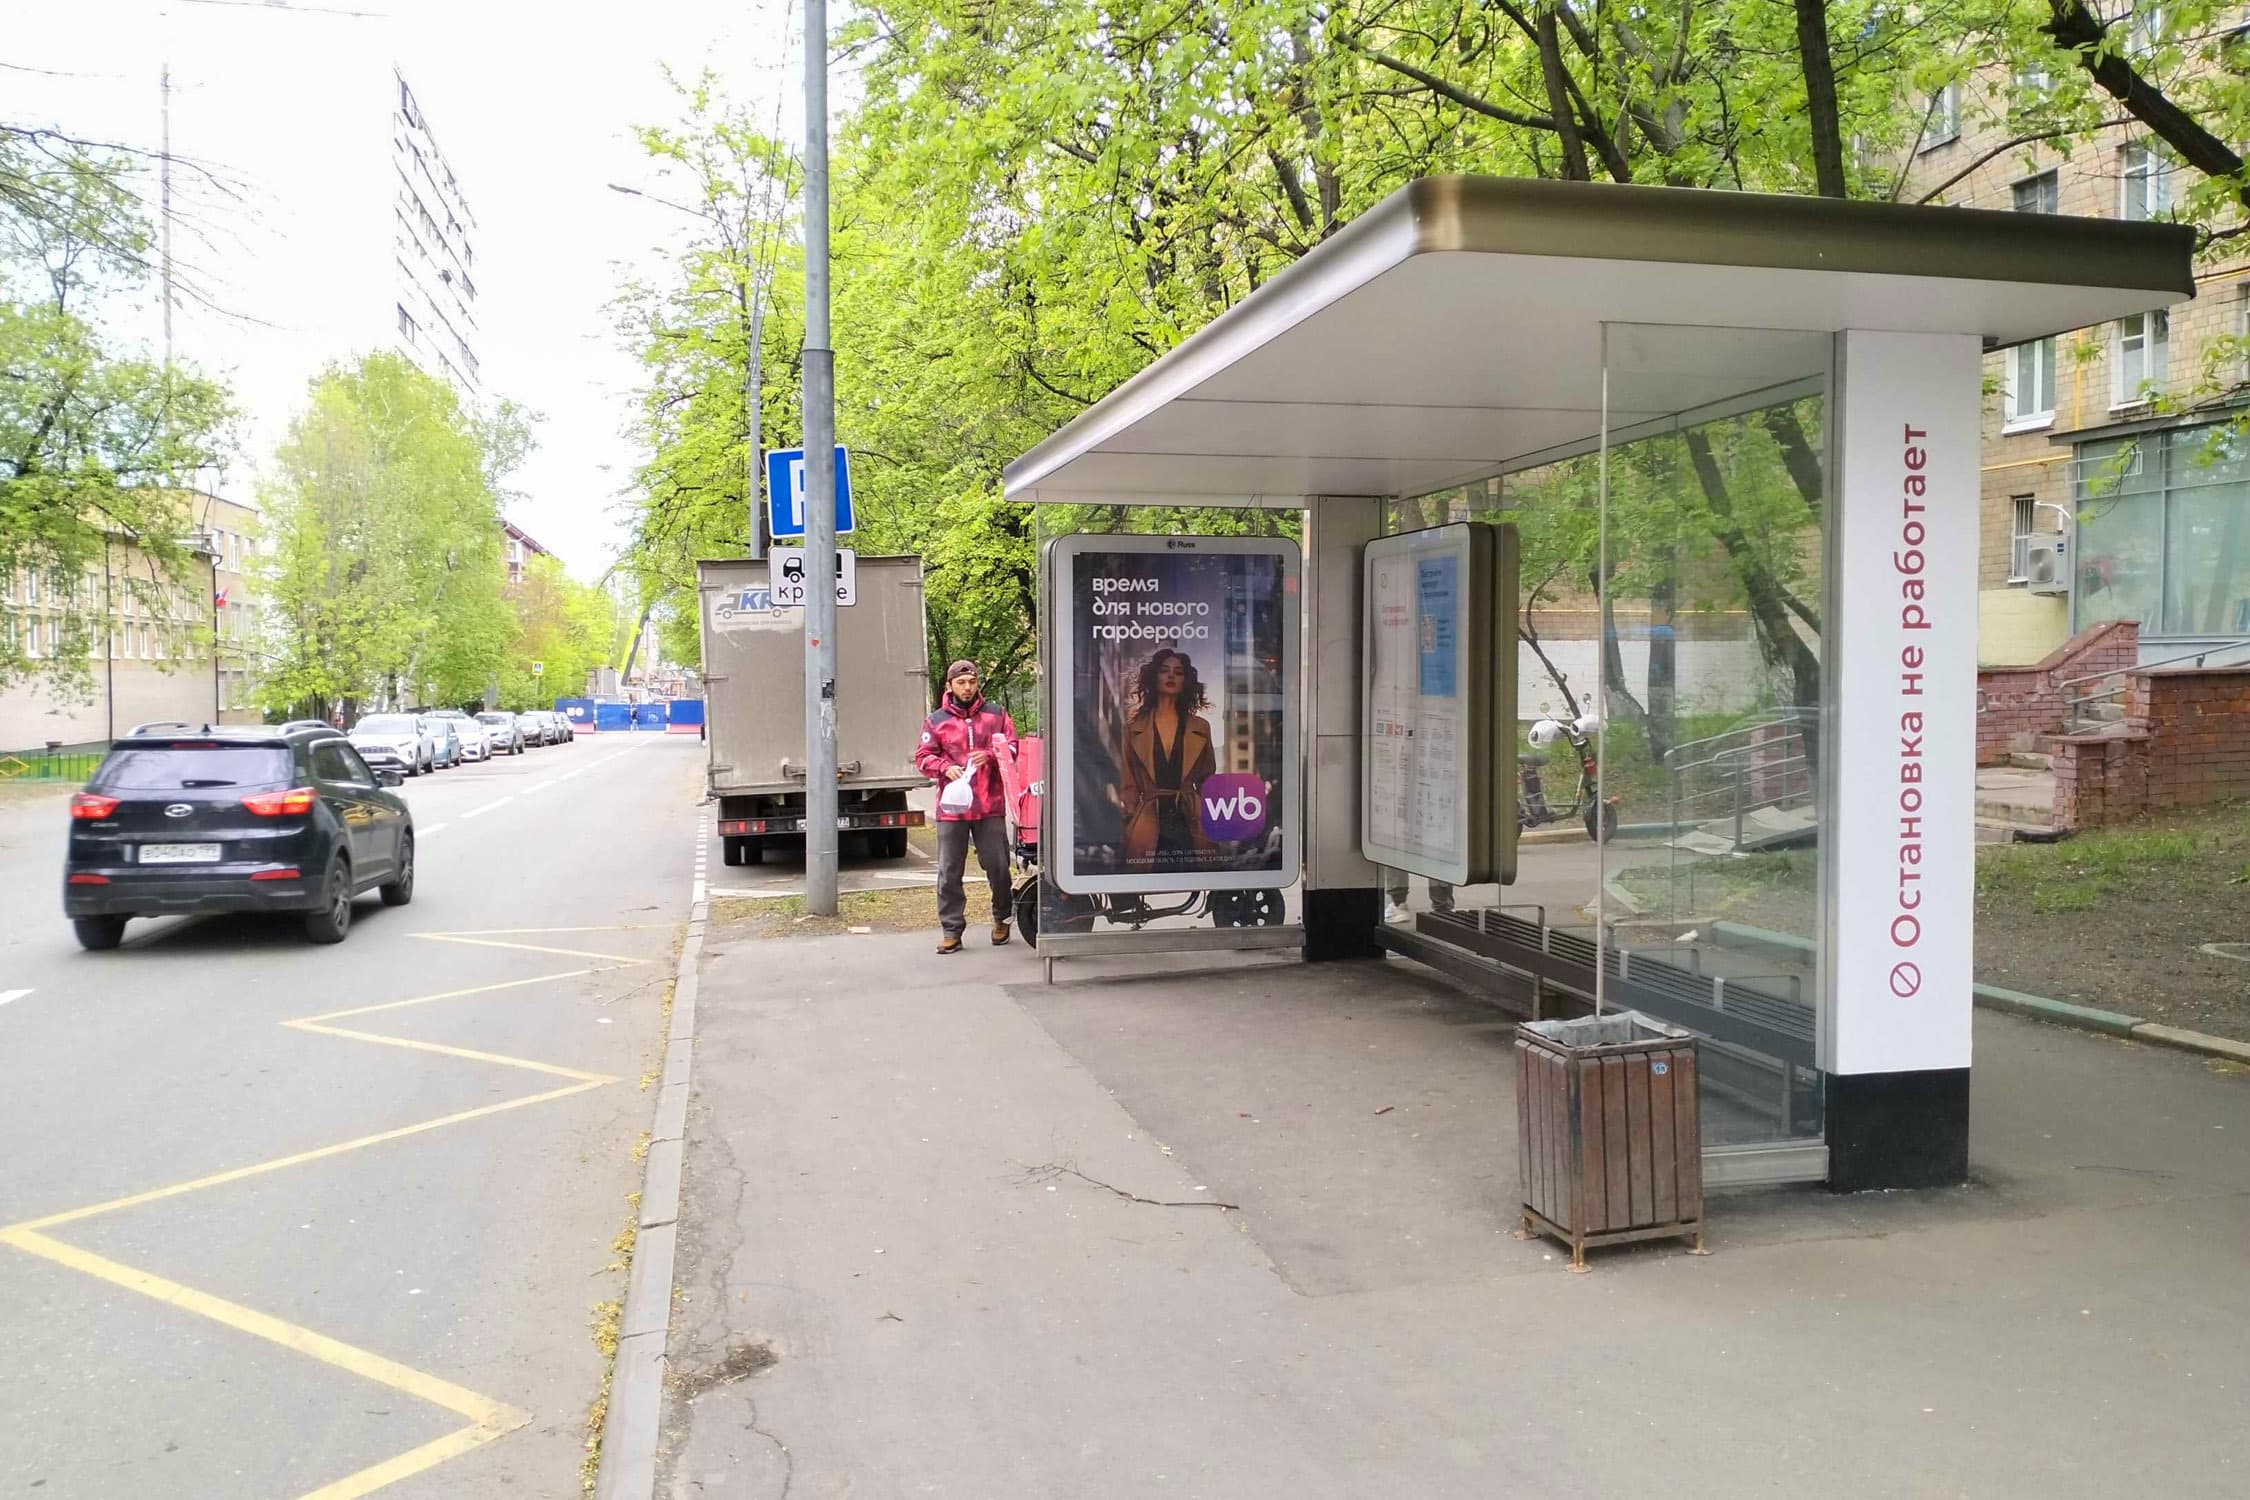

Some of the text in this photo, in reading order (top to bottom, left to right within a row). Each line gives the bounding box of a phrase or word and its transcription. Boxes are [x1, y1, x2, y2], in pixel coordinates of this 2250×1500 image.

[778, 585, 848, 603] кре
[1092, 577, 1159, 596] время
[1092, 595, 1209, 615] для нового
[1092, 620, 1209, 643] гардероба
[1890, 423, 1932, 948] Остановка не работает
[1204, 786, 1262, 820] wb
